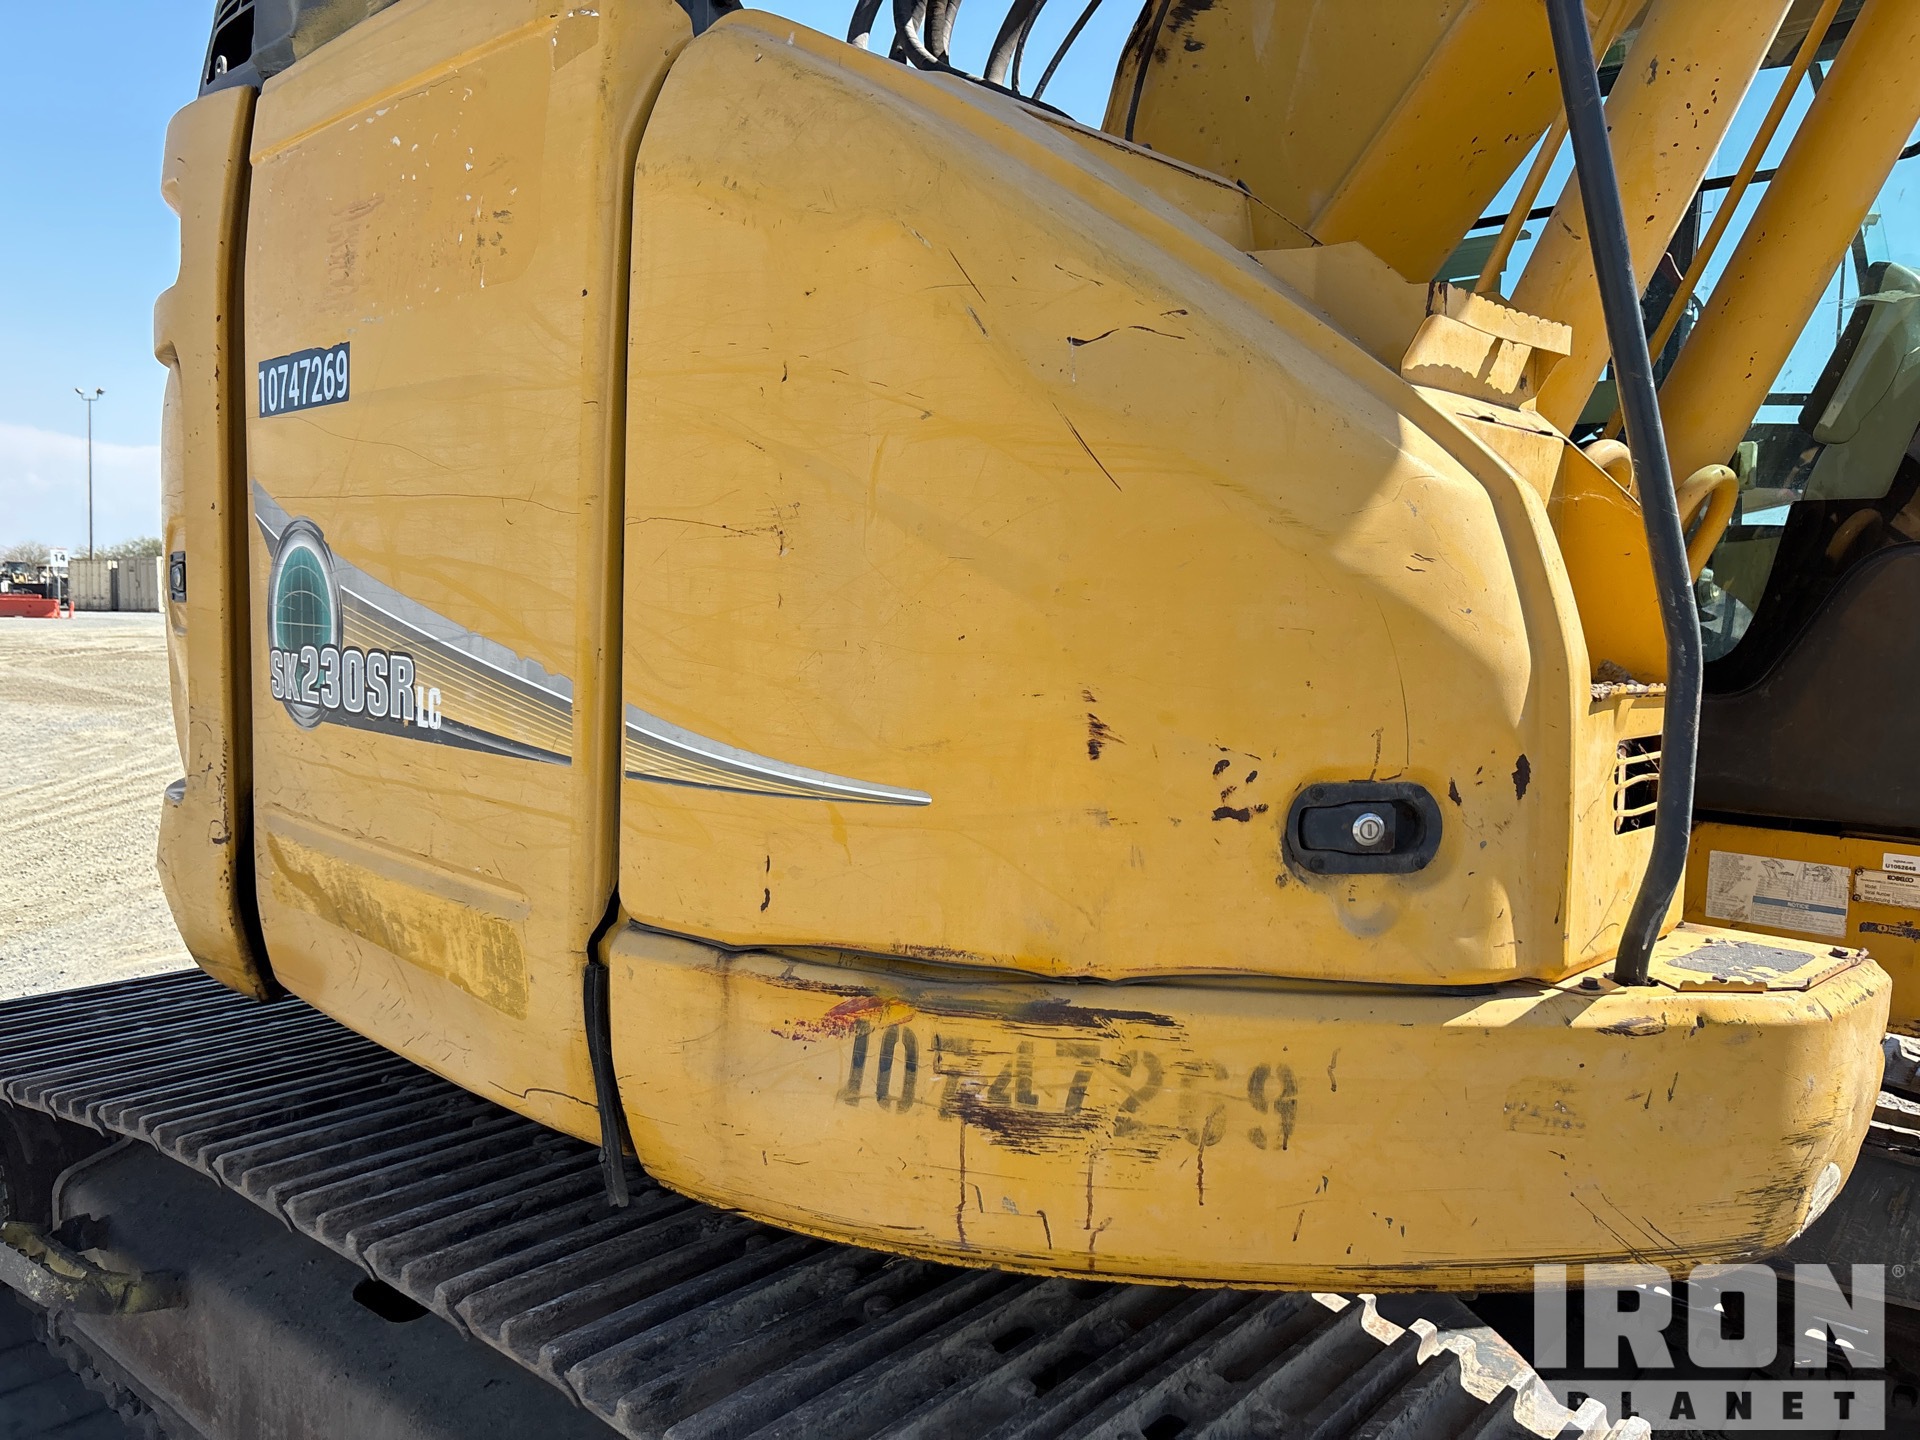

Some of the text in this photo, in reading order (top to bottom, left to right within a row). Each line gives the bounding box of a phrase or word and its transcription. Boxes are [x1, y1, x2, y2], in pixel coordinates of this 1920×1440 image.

[258, 350, 348, 413] 10747269
[54, 554, 66, 562] 14
[1887, 874, 1914, 883] KOBELCO
[1787, 901, 1810, 910] NOTICE
